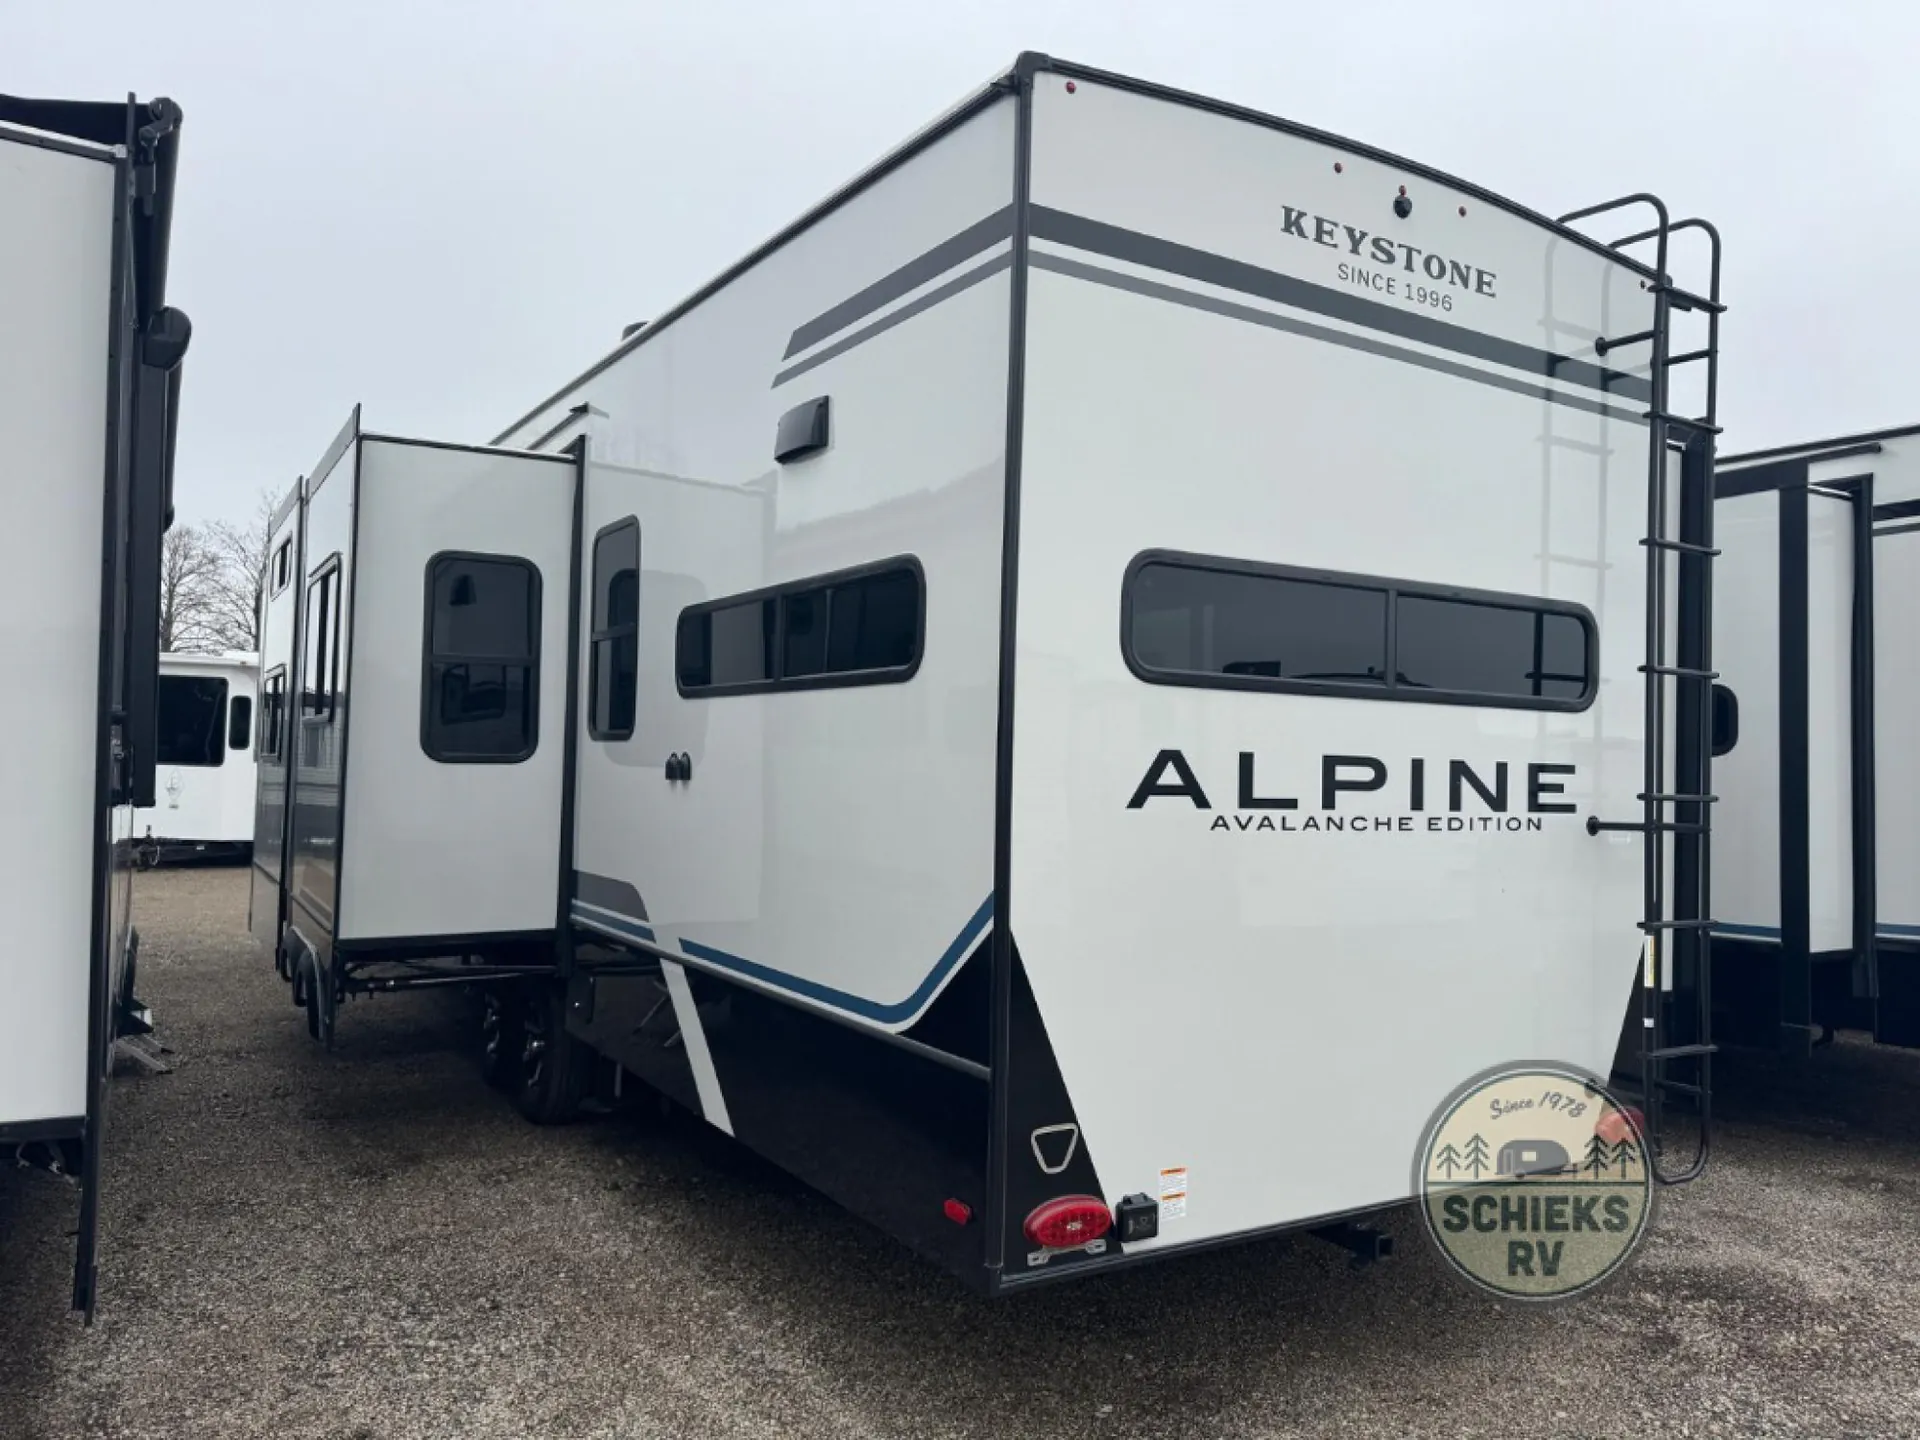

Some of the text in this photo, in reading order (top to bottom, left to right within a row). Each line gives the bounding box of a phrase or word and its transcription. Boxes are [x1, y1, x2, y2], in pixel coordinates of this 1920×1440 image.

[1281, 205, 1497, 298] KEYSTONE
[1337, 263, 1453, 312] SINCE 1996
[1126, 749, 1577, 814] ALPINE
[1210, 815, 1543, 832] AVALANCHE EDITION
